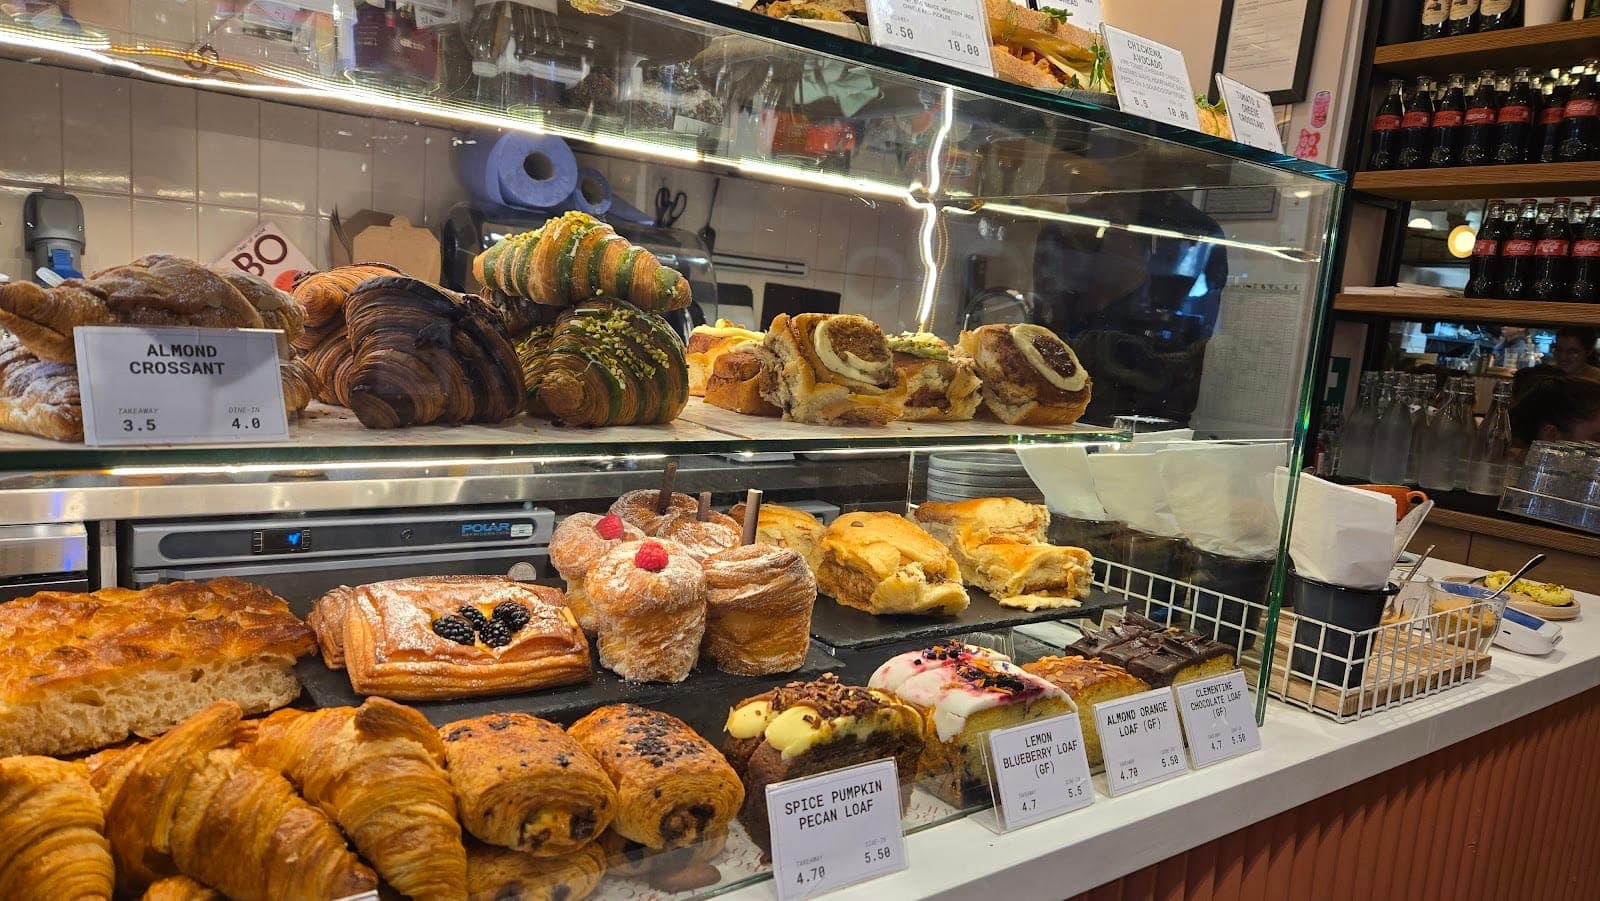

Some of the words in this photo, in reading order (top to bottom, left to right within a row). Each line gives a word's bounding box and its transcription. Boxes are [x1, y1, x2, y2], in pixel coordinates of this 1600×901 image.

[885, 22, 914, 40] 8.50
[947, 39, 980, 56] 10.00
[1133, 53, 1163, 70] AVOCADO
[1134, 96, 1149, 109] 8.5
[1167, 107, 1189, 120] 10.00
[147, 344, 217, 358] ALMOND
[130, 361, 225, 375] CROSSANT
[118, 407, 159, 415] TAKEAWAY
[123, 418, 157, 431] 3.5
[231, 417, 261, 429] 4.0
[461, 522, 510, 533] POLAR
[1195, 681, 1233, 698] CLEMENTINE
[1190, 695, 1225, 711] CHOCOLATE
[1227, 691, 1241, 702] LOAF
[1107, 709, 1136, 726] ALMOND
[1140, 701, 1168, 717] ORANGE
[1212, 706, 1227, 720] (GF)
[1119, 723, 1138, 737] LOAF
[1143, 717, 1161, 733] (GF)
[1025, 731, 1053, 748] LEMON
[1211, 740, 1222, 751] 4.7
[1231, 733, 1246, 745] 5.50
[1003, 747, 1052, 769] BLUEBERRY
[1056, 740, 1078, 755] LOAF
[1161, 754, 1179, 768] 5.50
[1034, 761, 1055, 779] (GF)
[1120, 767, 1138, 780] 4.70
[785, 794, 824, 816] SPICE
[831, 779, 882, 803] PUMPKIN
[1068, 786, 1083, 798] 5.5
[1022, 799, 1036, 812] 4.7
[799, 809, 838, 830] PECAN
[845, 799, 873, 818] LOAF
[864, 846, 891, 863] 5.50
[796, 865, 825, 885] 4.70
